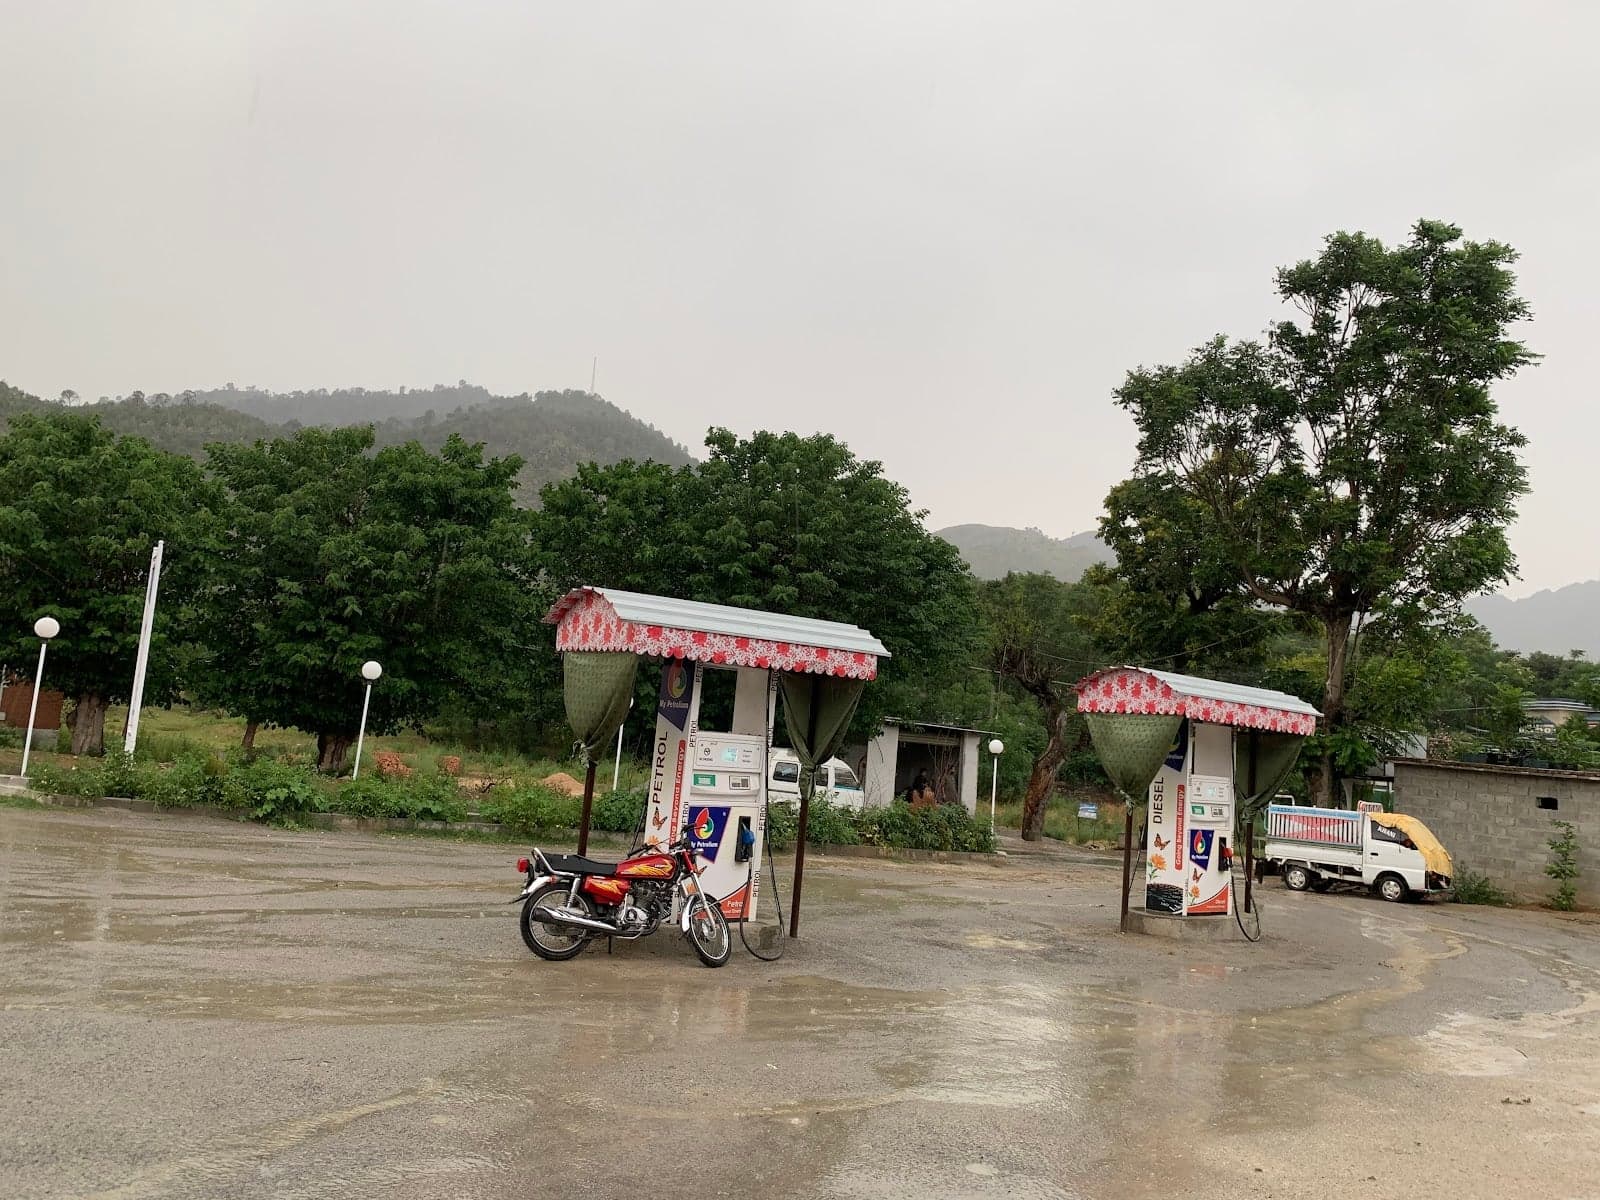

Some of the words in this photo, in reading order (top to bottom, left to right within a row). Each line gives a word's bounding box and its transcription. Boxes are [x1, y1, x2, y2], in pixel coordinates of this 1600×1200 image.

[689, 720, 697, 748] PETROL
[652, 731, 668, 804] PETROL
[676, 746, 685, 784] Energy
[672, 787, 681, 823] Beyond
[681, 801, 689, 825] ETROL
[1153, 776, 1164, 824] DIESEL
[753, 870, 761, 897] PETROL
